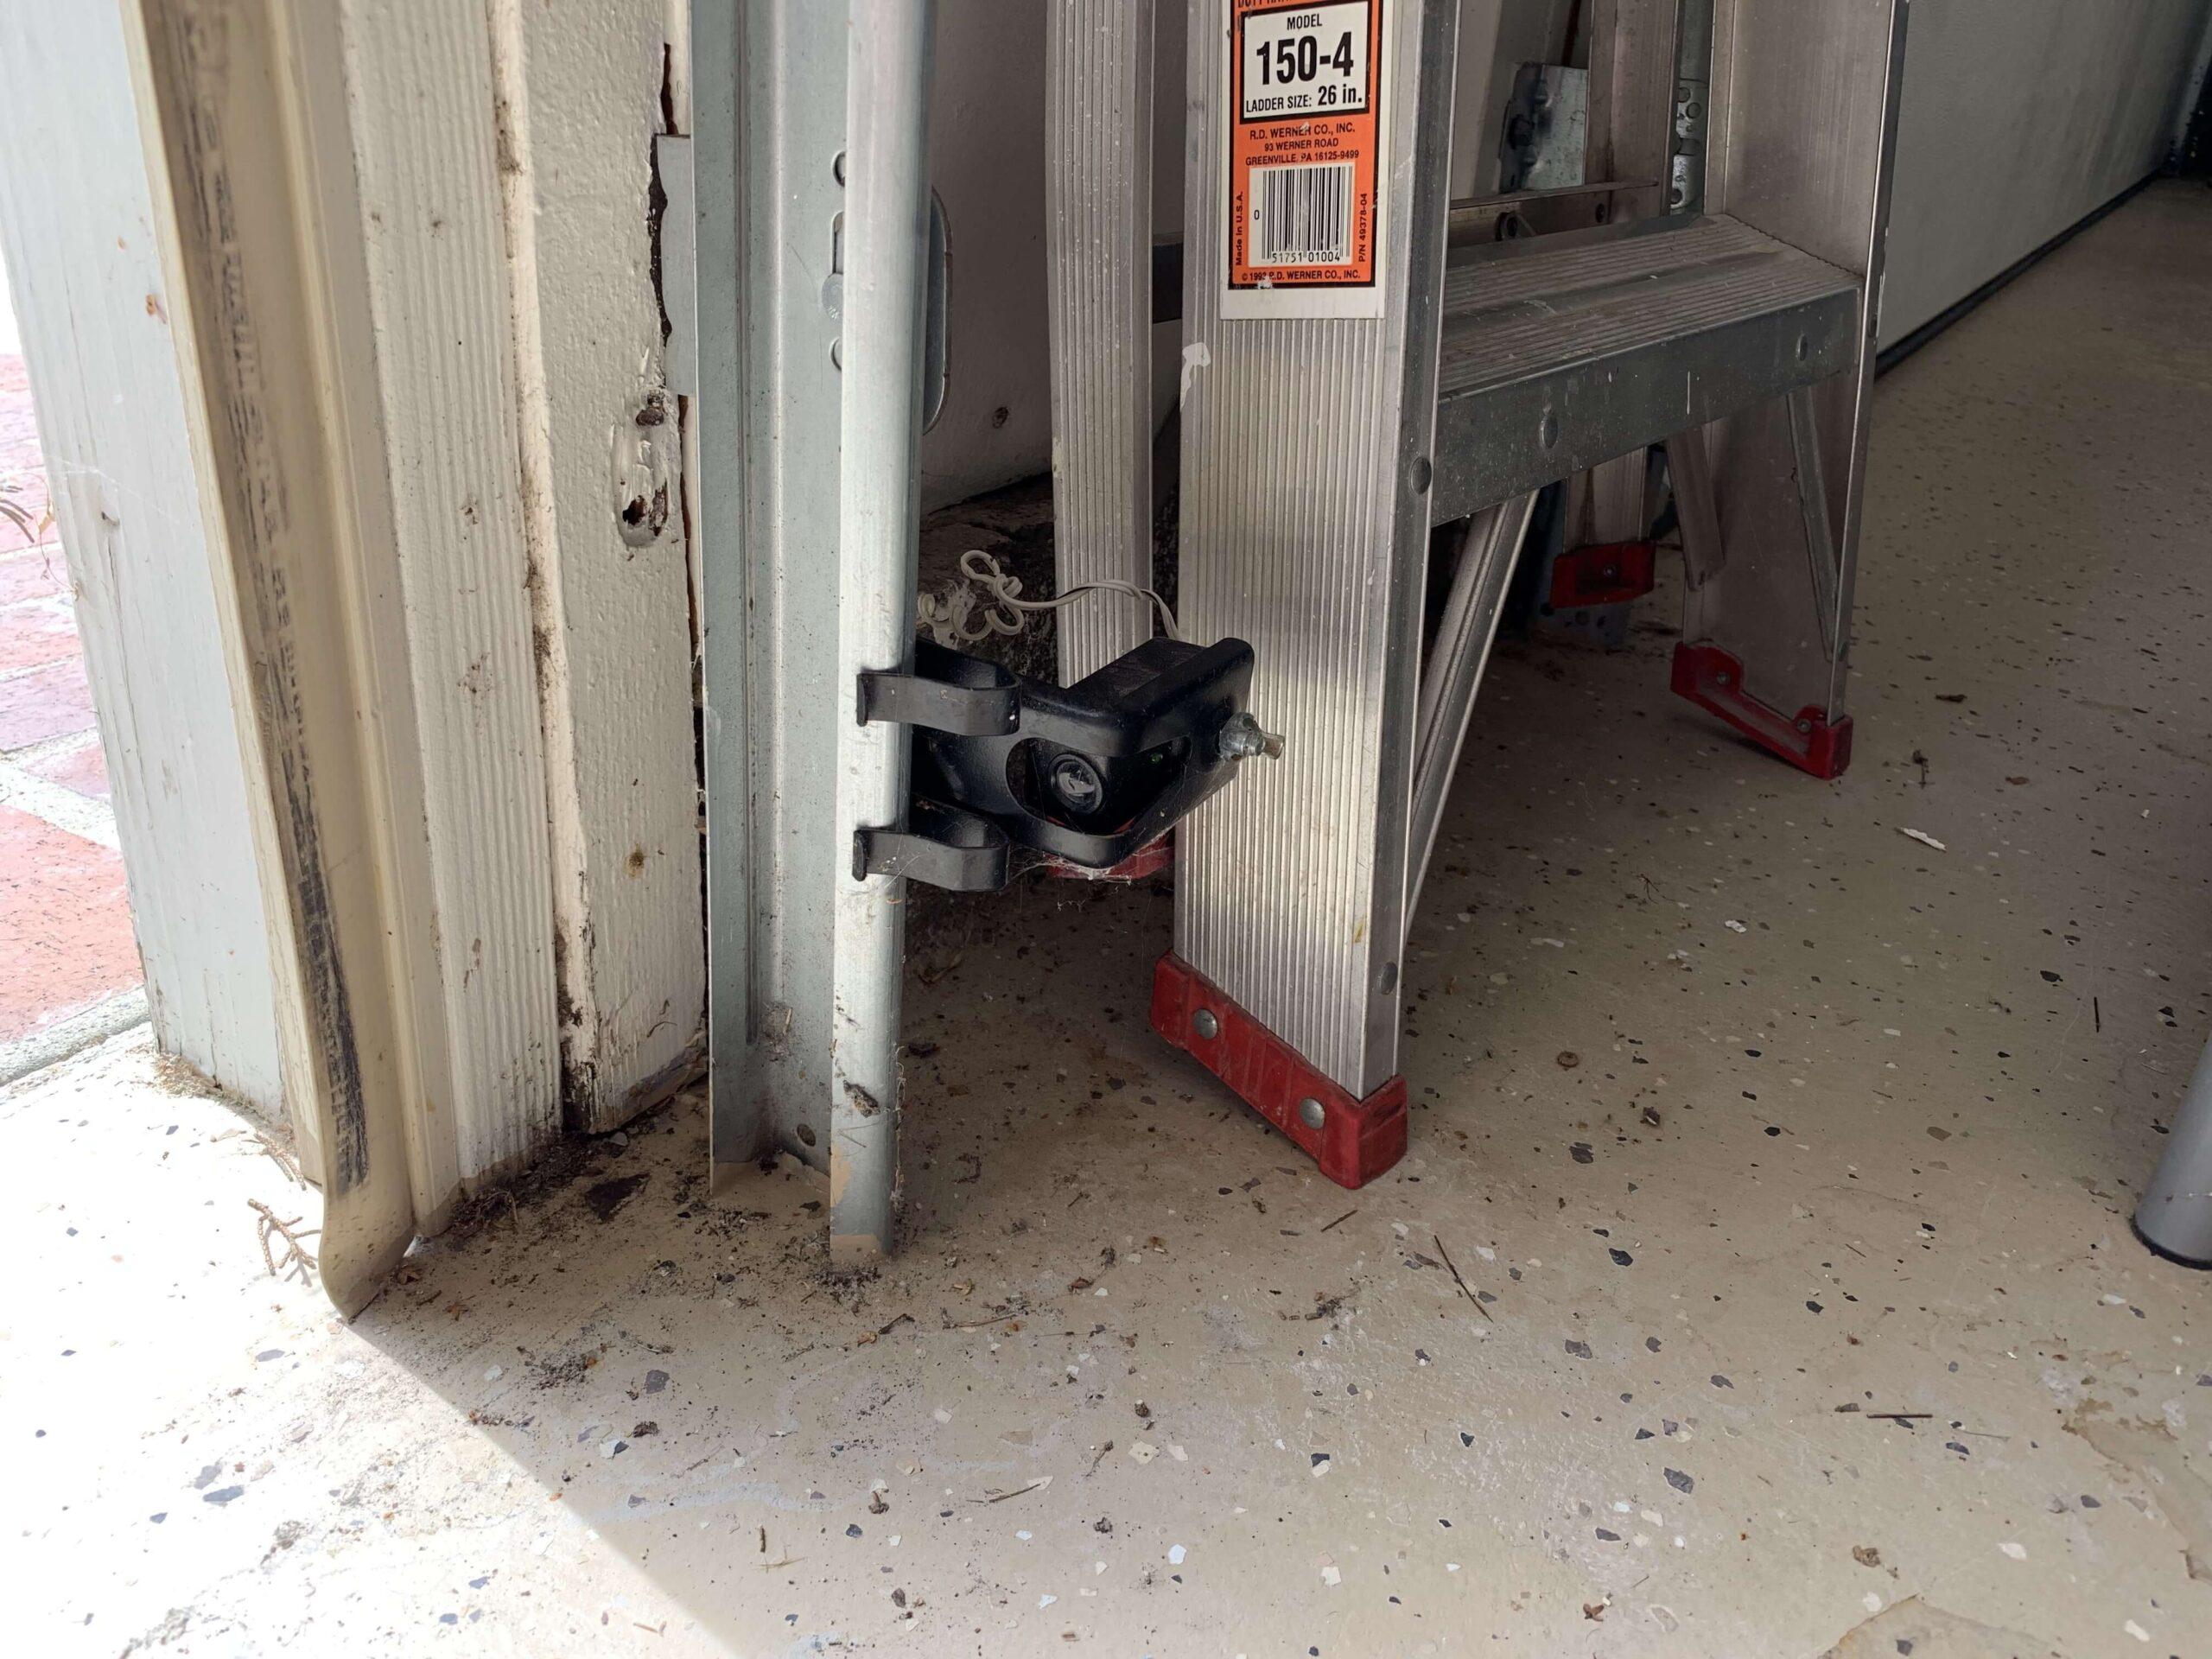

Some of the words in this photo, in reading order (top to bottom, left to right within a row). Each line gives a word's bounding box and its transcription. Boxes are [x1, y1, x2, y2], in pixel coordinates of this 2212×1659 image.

[1287, 13, 1323, 30] MODEL
[1256, 31, 1354, 86] 150-4
[1246, 97, 1284, 113] LADDER
[1287, 94, 1312, 109] SIZE:
[1318, 85, 1337, 105] 26
[1342, 84, 1363, 104] in.
[1249, 129, 1268, 140] R.D.
[1270, 125, 1311, 138] WERNER
[1313, 124, 1333, 136] CO.,
[1336, 122, 1356, 134] INC.
[1264, 143, 1274, 152] 93
[1275, 140, 1312, 150] WERNER
[1314, 137, 1339, 148] ROAD
[1314, 149, 1359, 162] 16125-9499
[1254, 209, 1260, 220] 0
[1359, 193, 1368, 241] 49378-04
[1272, 252, 1302, 264] 51751
[1307, 251, 1340, 263] 01004
[1287, 270, 1323, 279] WERNER
[1324, 270, 1342, 281] CO.,
[1344, 269, 1361, 279] INC.
